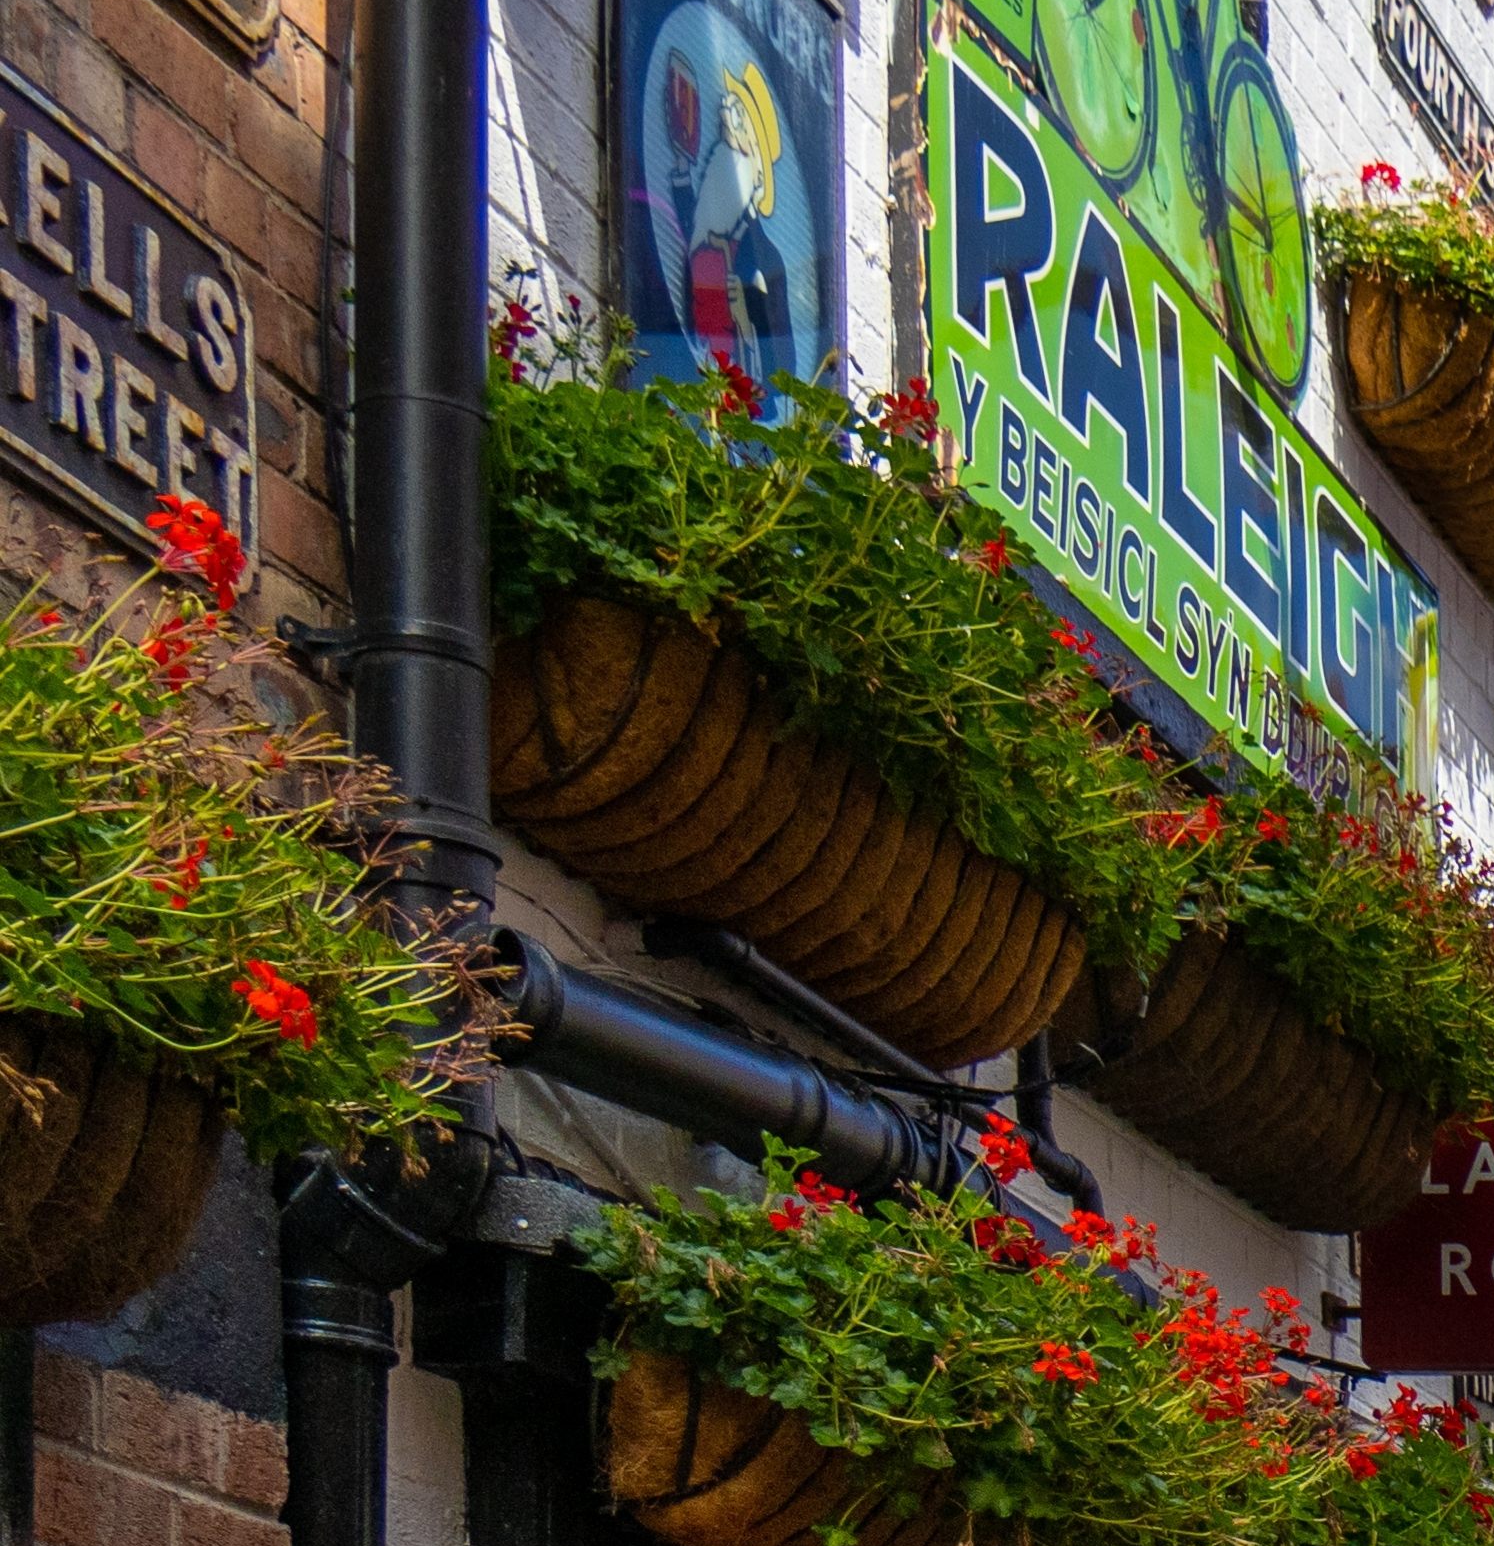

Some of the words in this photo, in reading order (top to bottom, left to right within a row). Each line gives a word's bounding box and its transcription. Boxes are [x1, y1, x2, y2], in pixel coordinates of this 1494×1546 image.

[0, 113, 238, 393] ELLS
[947, 348, 988, 467] Y
[999, 395, 1168, 654] BEISICL
